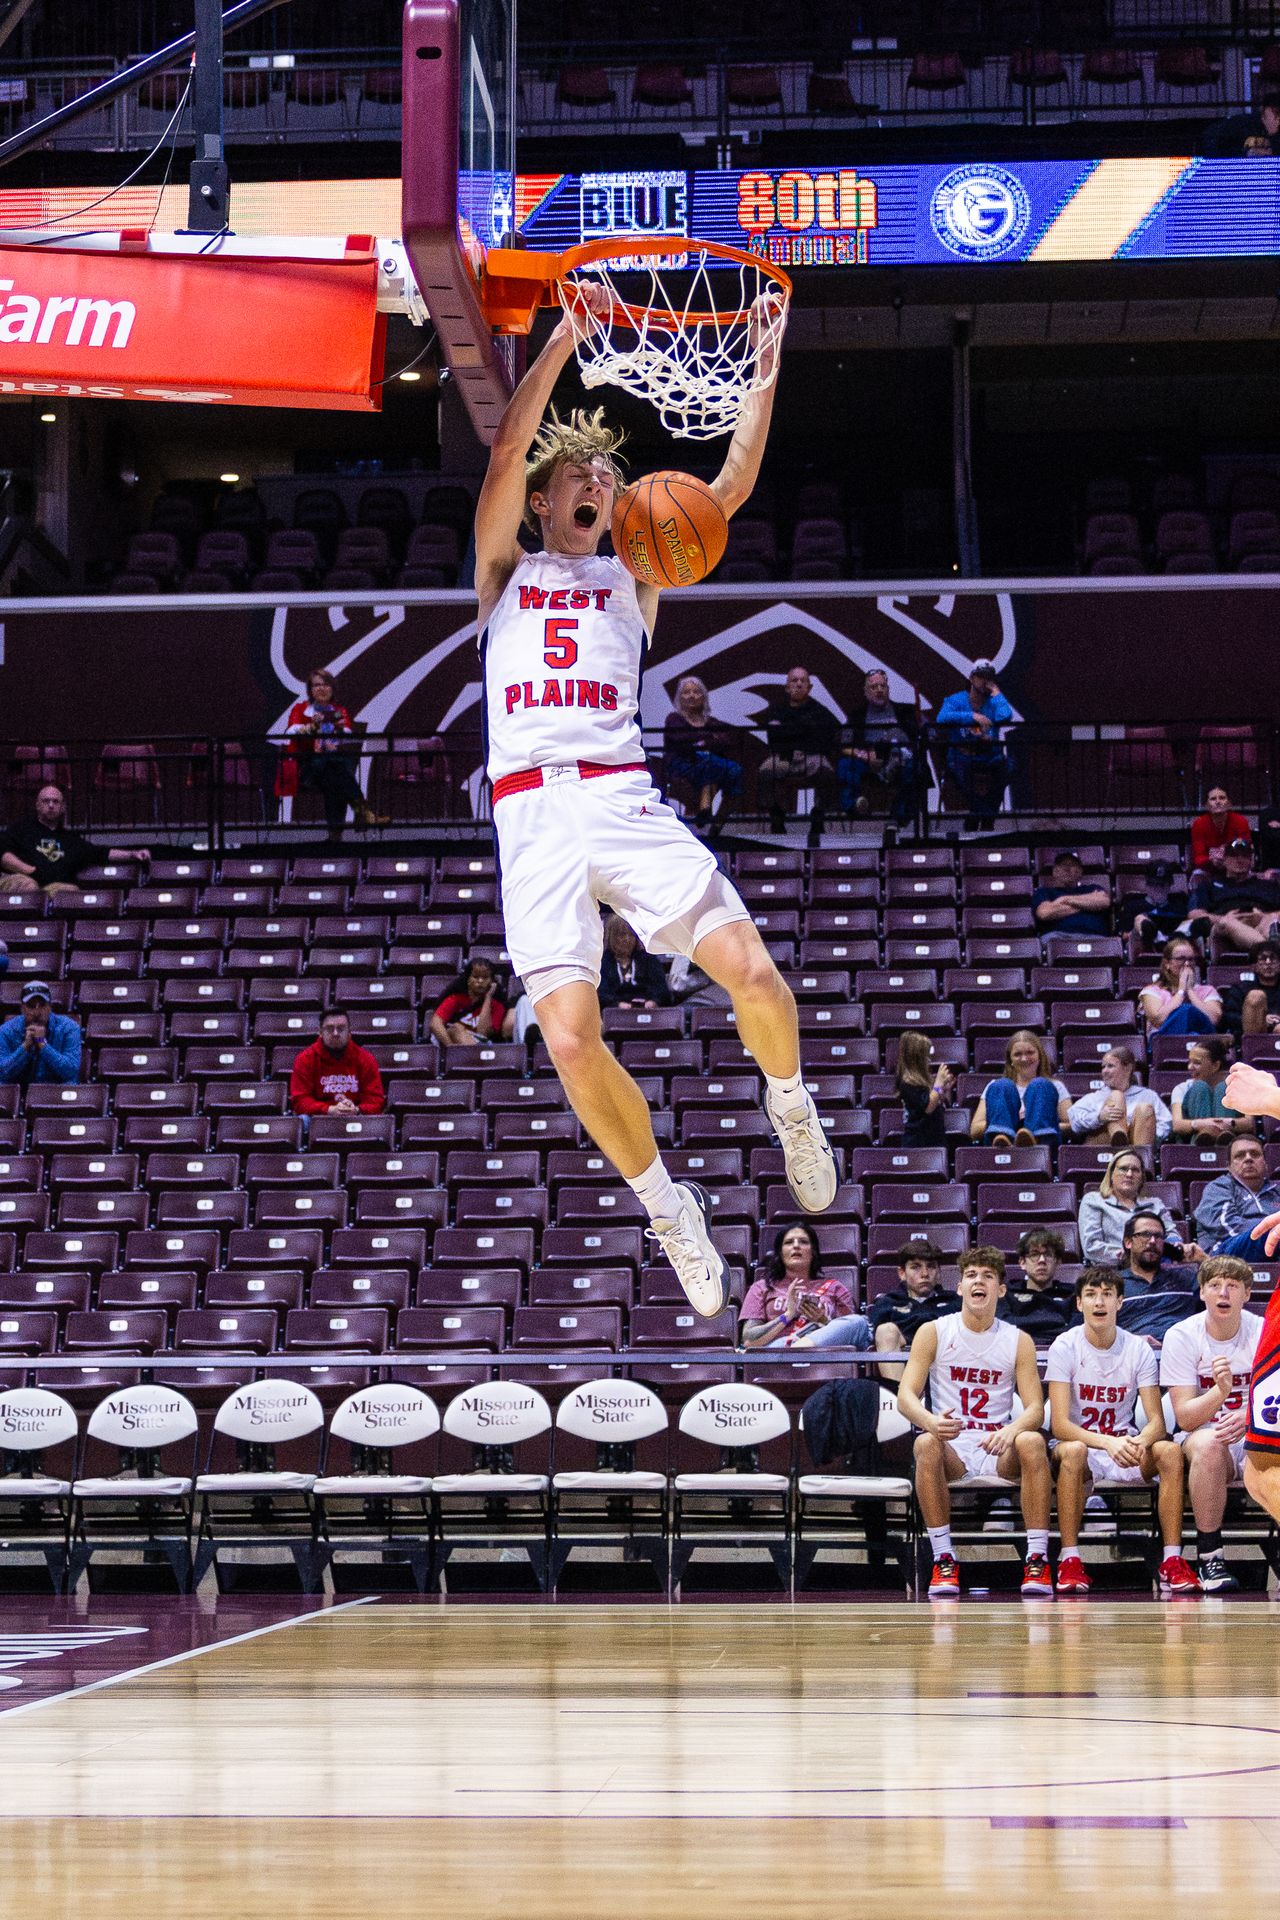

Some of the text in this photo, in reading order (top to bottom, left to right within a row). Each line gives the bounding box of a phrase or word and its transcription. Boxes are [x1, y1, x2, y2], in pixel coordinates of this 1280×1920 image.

[738, 169, 877, 230] 80th
[658, 516, 695, 584] SPALDIN
[518, 585, 613, 612] WEST
[543, 618, 579, 670] 5
[504, 678, 619, 715] PLAINS
[949, 1365, 1003, 1386] WEST
[1198, 1372, 1252, 1390] WST
[575, 1393, 651, 1410] Missouri
[1078, 1383, 1127, 1404] WEST
[106, 1400, 182, 1416] Missouri
[234, 1394, 309, 1412] Missouri
[348, 1399, 423, 1415] Missouri
[461, 1397, 535, 1413] Missouri
[698, 1398, 774, 1414] Missouri
[959, 1387, 990, 1420] 12
[122, 1414, 165, 1431] State
[250, 1409, 293, 1426] State
[364, 1413, 408, 1429] State
[477, 1411, 520, 1427] State
[592, 1408, 635, 1424] State
[714, 1412, 758, 1429] State
[3, 1417, 46, 1434] State
